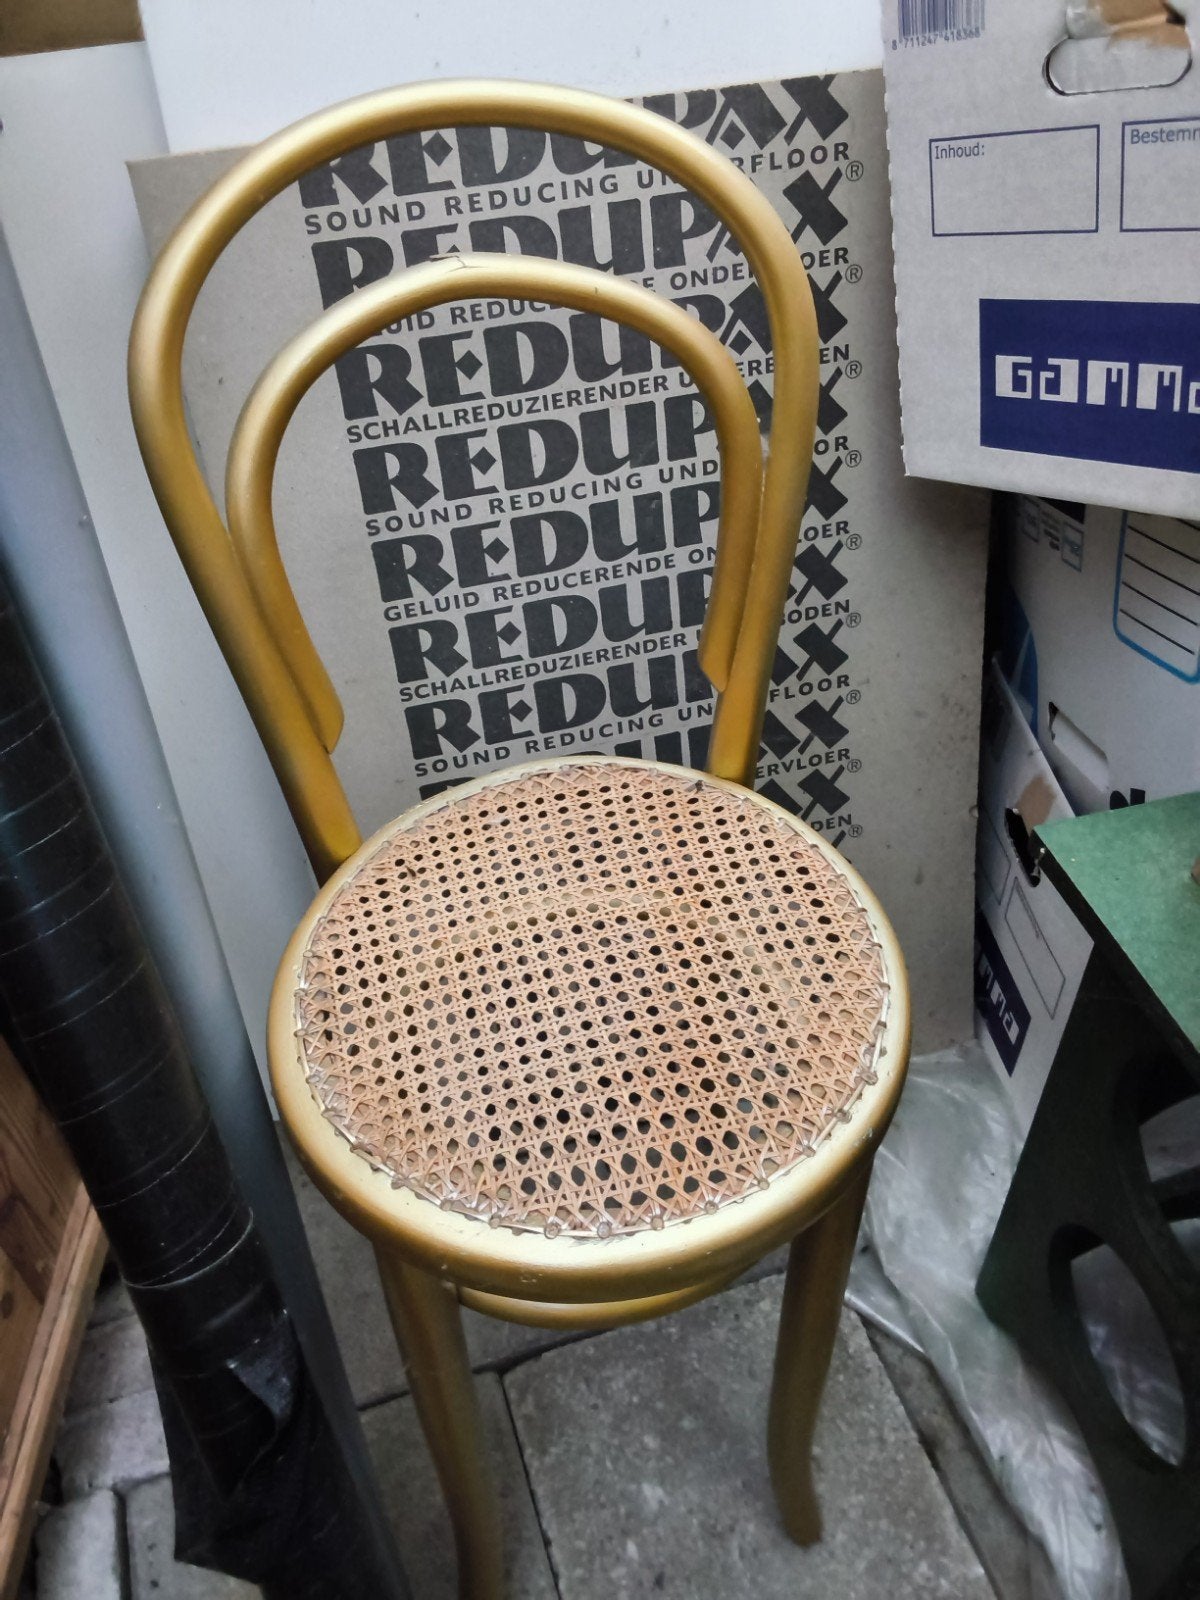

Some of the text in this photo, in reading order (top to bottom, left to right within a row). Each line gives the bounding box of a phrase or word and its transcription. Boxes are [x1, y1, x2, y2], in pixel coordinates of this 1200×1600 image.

[935, 142, 985, 160] Inhoud:
[304, 200, 426, 235] SOUND
[444, 174, 619, 217] REDUCING
[346, 375, 669, 443] SCHALLREDUZIERENDER
[365, 503, 472, 537] SOUND
[488, 472, 642, 515] REDUCING
[383, 591, 480, 622] GELUID
[493, 553, 676, 602] REDUCERENDE
[399, 632, 687, 702] SCHALLREDUZIERENDER
[415, 746, 510, 777] SOUND
[526, 714, 664, 754] REDUCING
